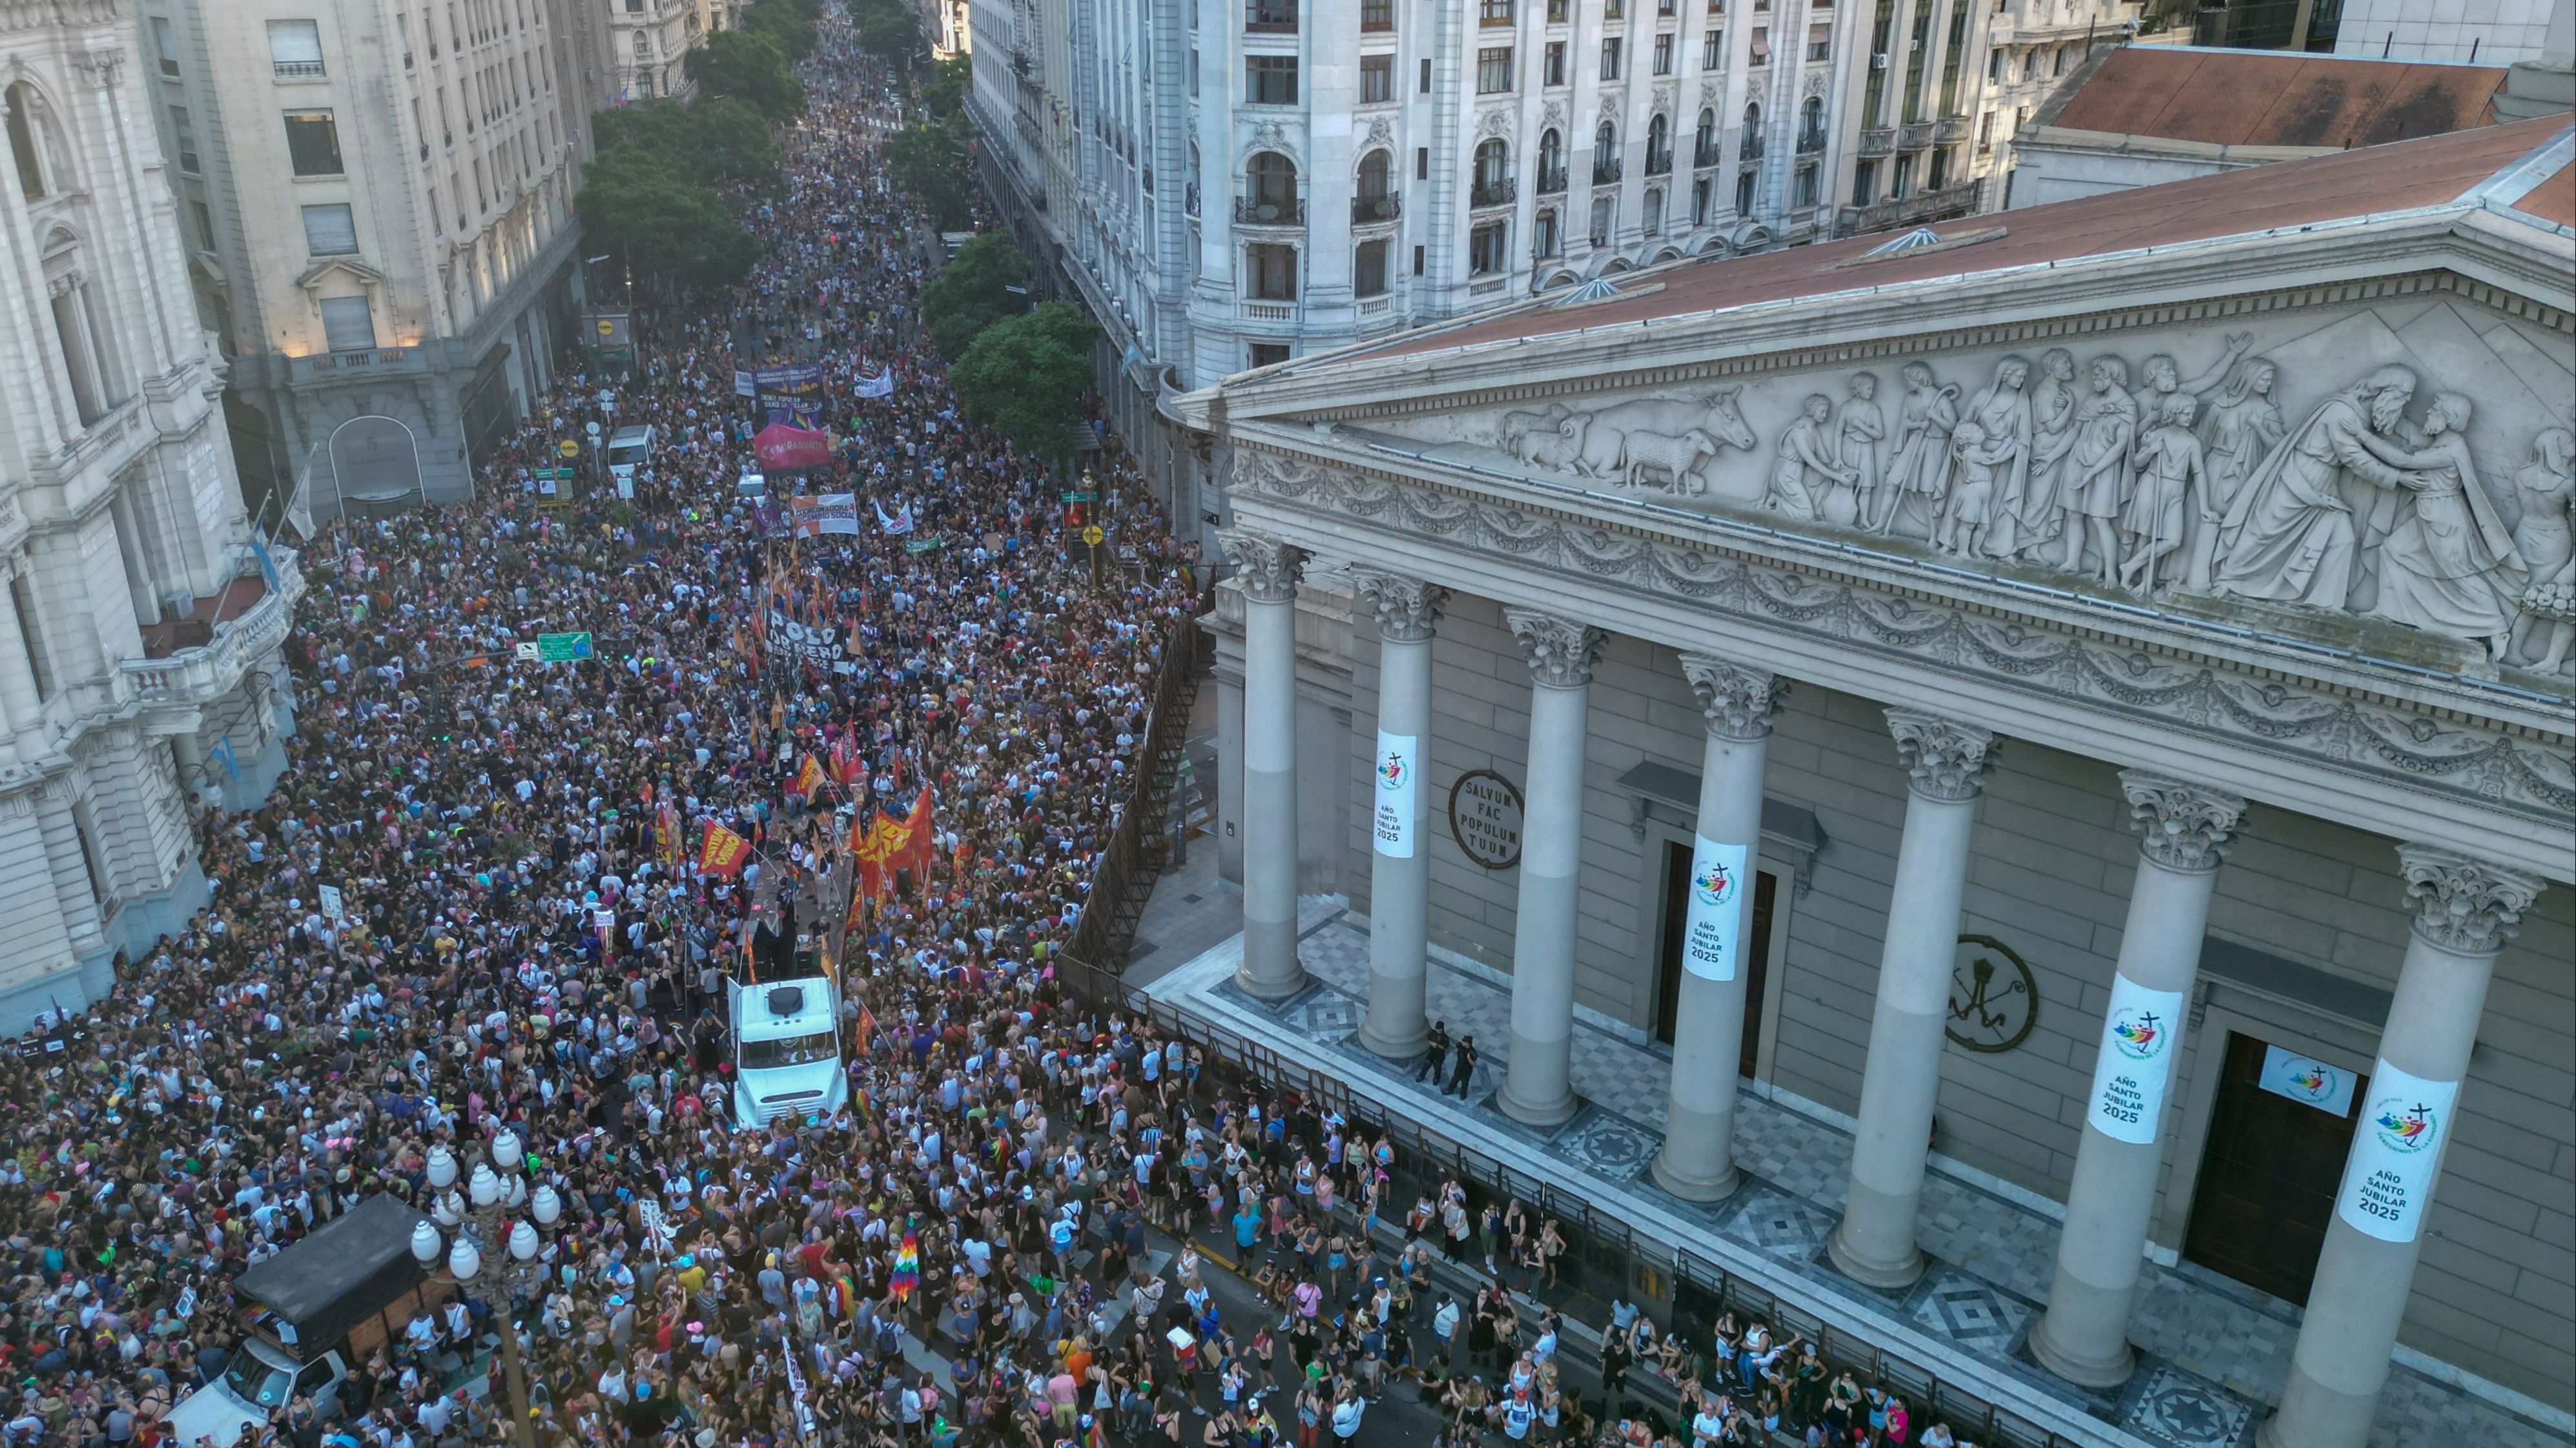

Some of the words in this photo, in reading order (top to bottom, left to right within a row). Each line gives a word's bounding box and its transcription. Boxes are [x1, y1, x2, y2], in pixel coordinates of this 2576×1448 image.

[796, 505, 849, 516] COORDINADORA
[803, 513, 830, 522] CAMBIO
[770, 609, 836, 645] POLO
[1466, 782, 1510, 807] SALVUM
[1379, 811, 1397, 823] SANTO
[1381, 805, 1394, 813] AÑO
[1478, 802, 1500, 820] FAC
[1377, 820, 1401, 831] JUBILAR
[1461, 814, 1516, 844] POPULUM
[1377, 828, 1399, 842] 2025
[1469, 834, 1506, 857] TUUM
[1698, 921, 1715, 931] AÑO
[1695, 928, 1719, 942] SANTO
[1691, 937, 1722, 952] JUBILAR
[1692, 946, 1718, 963] 2025
[2115, 1076, 2136, 1088] AÑO
[2108, 1083, 2141, 1100] SANTO
[2103, 1092, 2144, 1111] JUBILAR
[2103, 1103, 2138, 1124] 2025
[2376, 1170, 2400, 1184] AÑO
[2367, 1176, 2404, 1196] SANTO
[2359, 1185, 2406, 1208] JUBILAR
[2359, 1198, 2400, 1221] 2025
